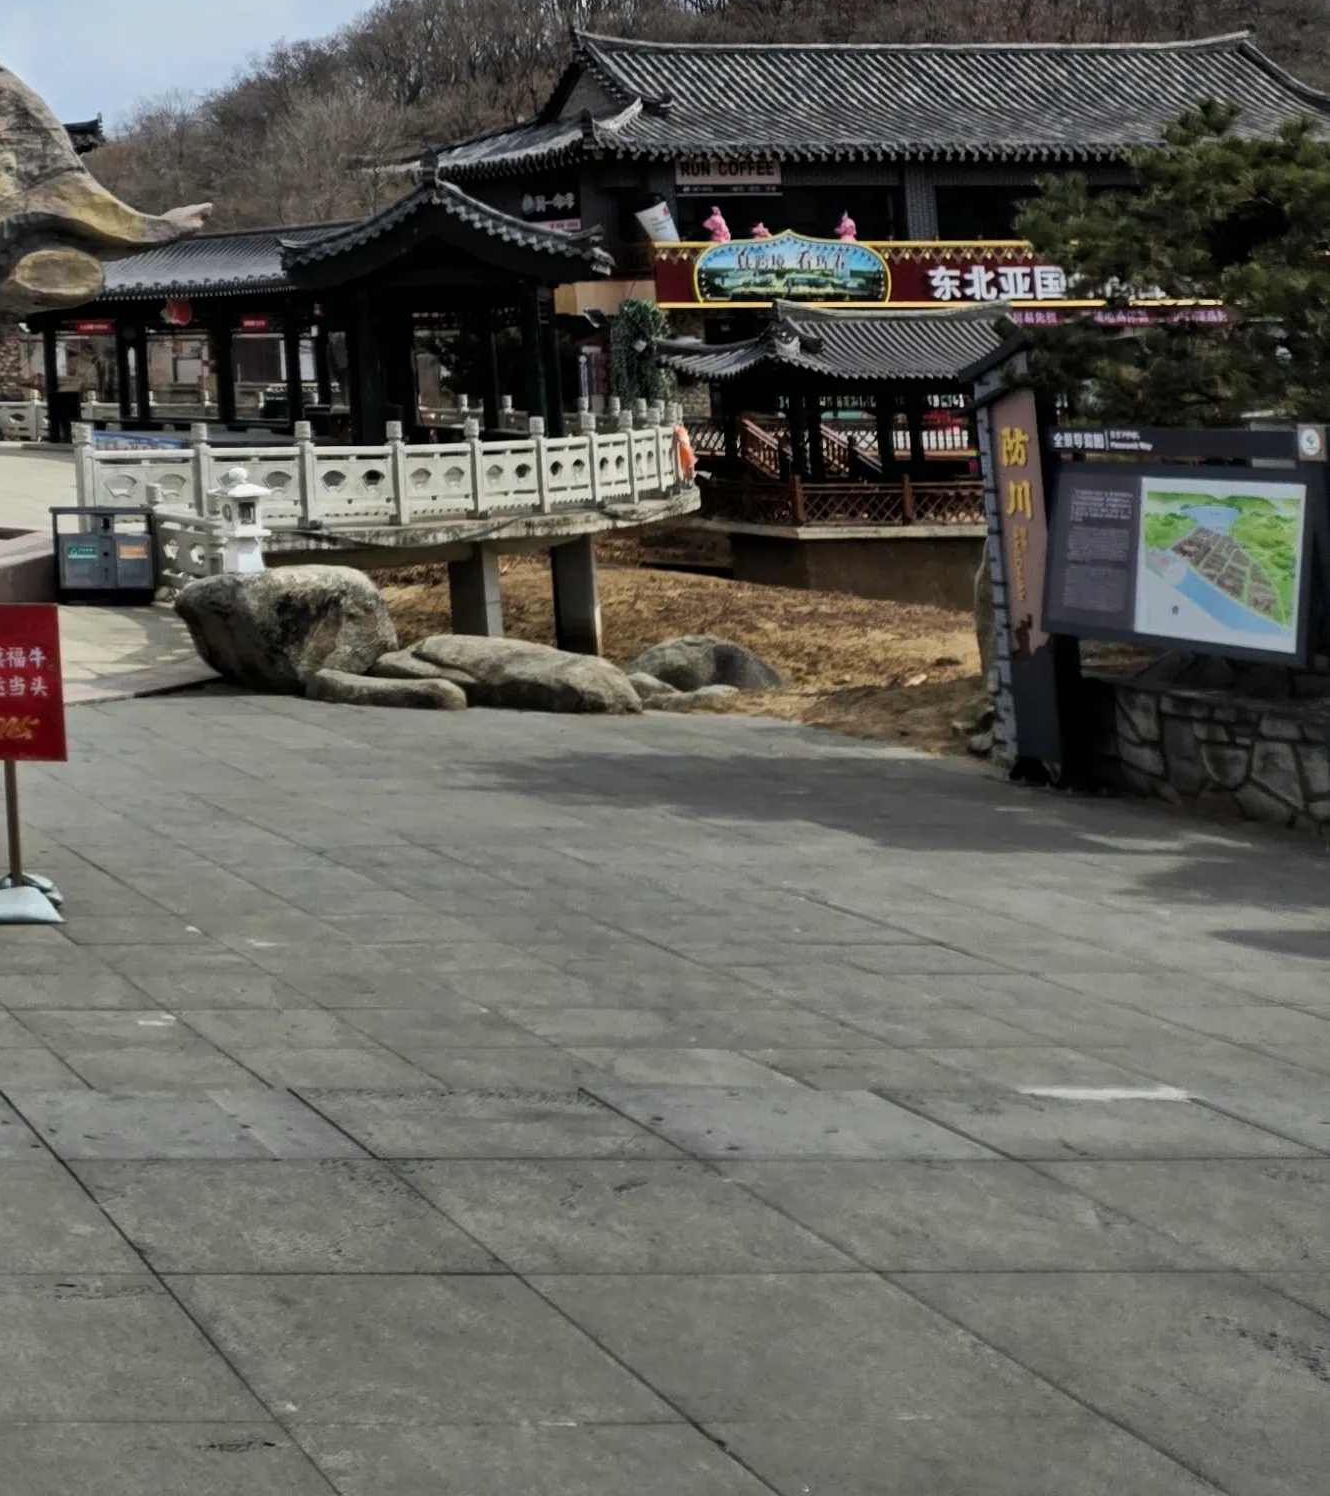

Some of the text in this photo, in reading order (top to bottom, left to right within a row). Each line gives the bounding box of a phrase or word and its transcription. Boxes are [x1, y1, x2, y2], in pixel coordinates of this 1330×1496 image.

[680, 160, 775, 177] RUN COFFEE
[1000, 426, 1033, 519] 防川
